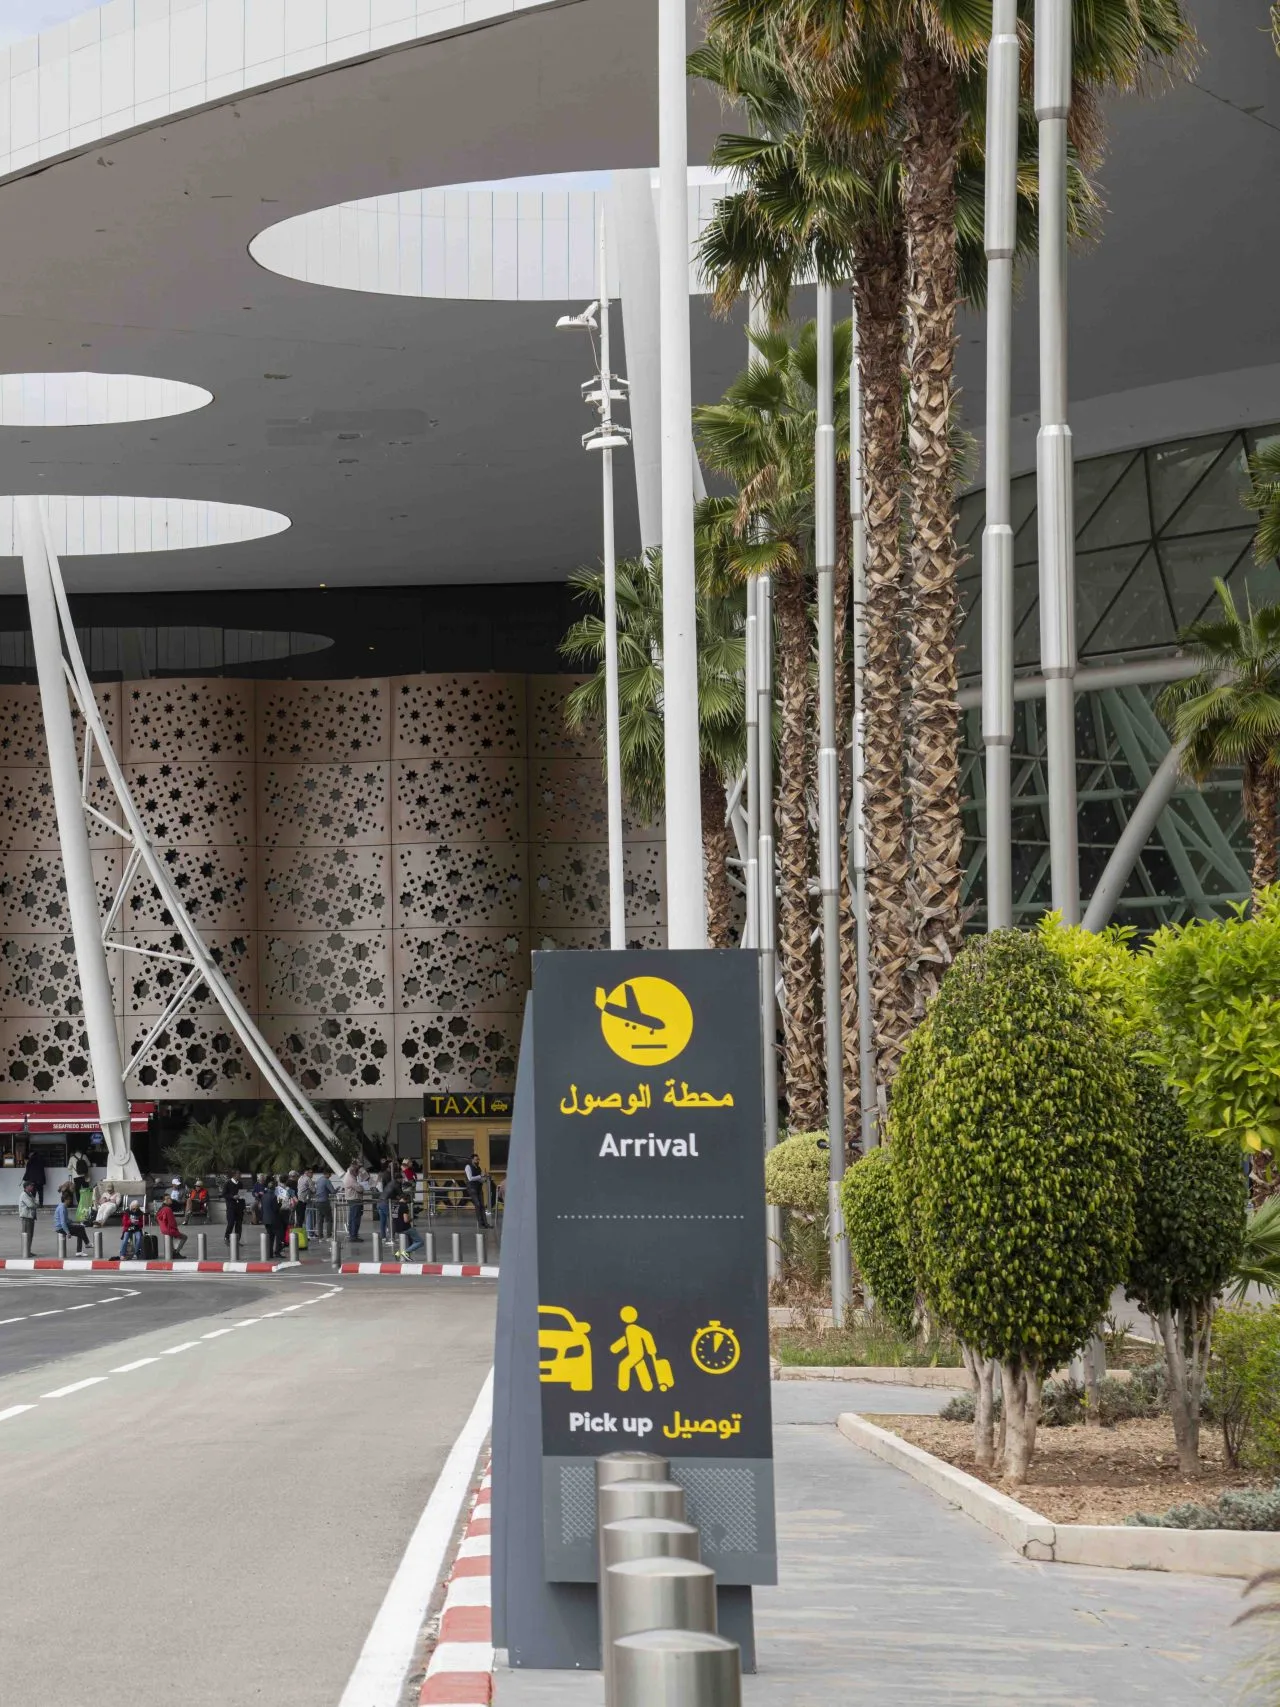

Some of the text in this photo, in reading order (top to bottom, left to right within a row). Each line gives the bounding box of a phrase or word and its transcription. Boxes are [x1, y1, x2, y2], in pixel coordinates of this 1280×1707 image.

[431, 1096, 486, 1114] TAXI
[559, 1078, 735, 1117] محطة الوصول
[598, 1132, 699, 1157] Arrival
[569, 1411, 654, 1438] Pick up
[662, 1411, 742, 1440] توصيل
